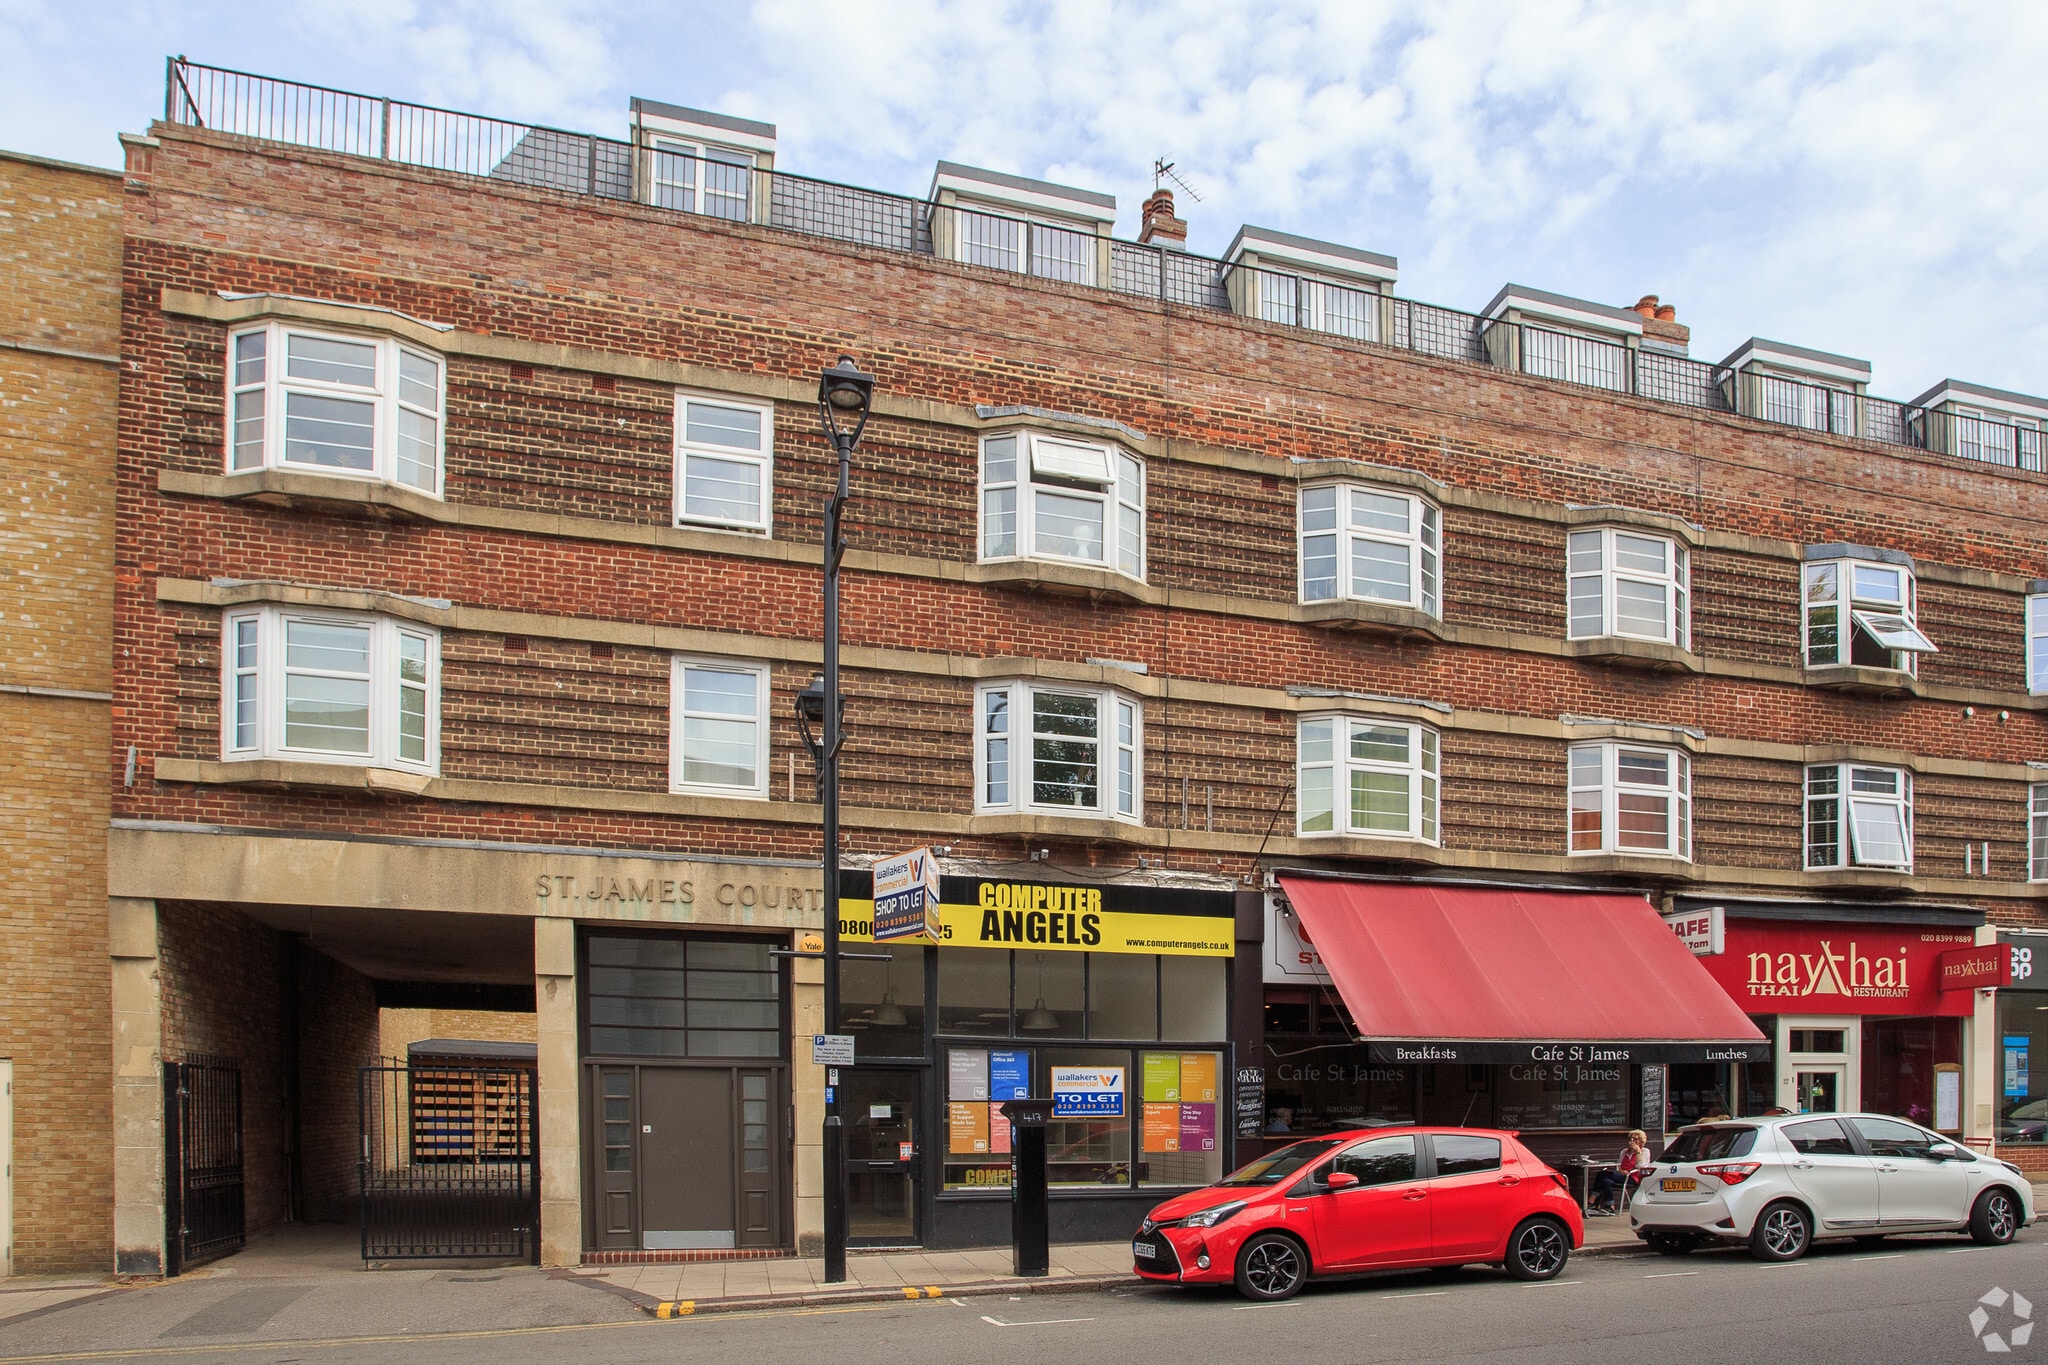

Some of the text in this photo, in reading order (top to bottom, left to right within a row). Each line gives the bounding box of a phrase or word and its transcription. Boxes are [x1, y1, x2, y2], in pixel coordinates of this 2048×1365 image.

[876, 863, 908, 880] wallakers
[587, 875, 695, 904] JAMES
[876, 875, 908, 893] commercial
[876, 898, 897, 916] SHOP
[899, 894, 909, 911] TO
[911, 891, 923, 908] LET
[979, 882, 1101, 912] COMPUTER
[876, 912, 924, 929] 020 8399 5381
[980, 910, 1101, 945] ANGELS
[1669, 918, 1709, 938] AFE
[805, 942, 822, 950] Yale
[1125, 938, 1229, 950] www.computerangels.co.uk
[1688, 940, 1709, 949] 7am
[1747, 984, 1909, 998] THAI RESTAURANT
[1397, 1046, 1457, 1060] Breakfasts
[1531, 1045, 1630, 1062] Cafe St James
[1706, 1048, 1748, 1060] Lunches
[831, 1069, 837, 1077] 8
[1277, 1063, 1404, 1084] Cafe St James
[1509, 1065, 1620, 1084] Cafe St James
[1057, 1094, 1119, 1103] TO LET
[1326, 1105, 1364, 1115] sausage
[1552, 1103, 1585, 1113] sausage
[1502, 1114, 1518, 1124] egg
[1602, 1115, 1625, 1124] bacon
[1663, 1180, 1680, 1190] LL67
